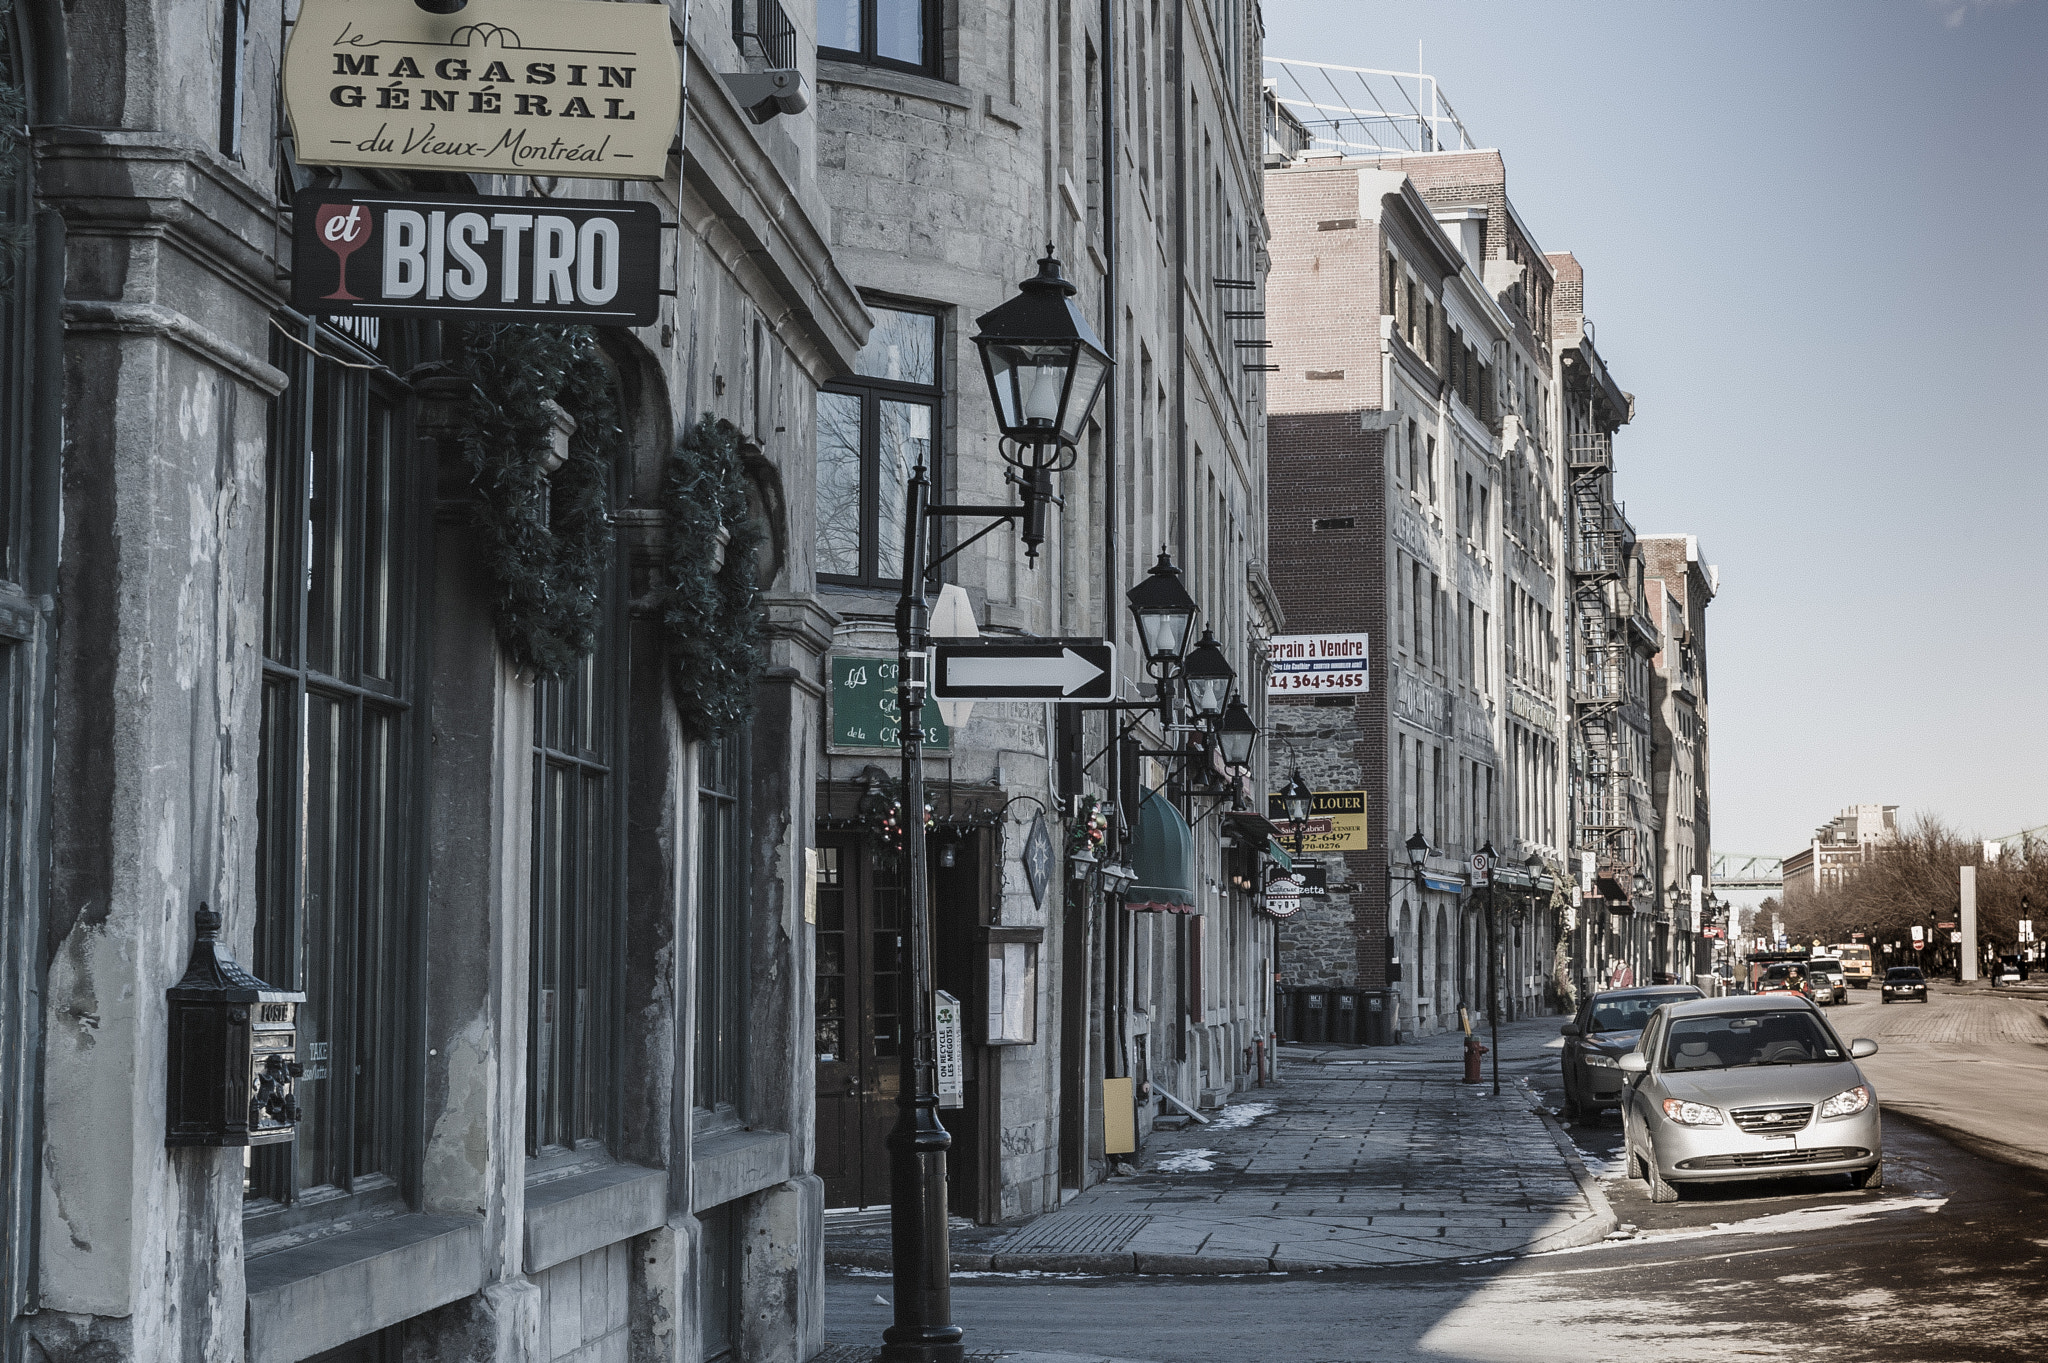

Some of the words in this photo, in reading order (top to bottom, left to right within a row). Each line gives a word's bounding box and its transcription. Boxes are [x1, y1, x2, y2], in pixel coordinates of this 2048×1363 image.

[332, 52, 637, 89] MAGASIN
[329, 81, 636, 121] GÉNÉRAL
[355, 122, 394, 153] du
[400, 123, 611, 167] Vieux-Montréal
[324, 205, 362, 243] et
[381, 208, 620, 306] BISTRO
[1268, 641, 1304, 658] errain
[1309, 640, 1315, 657] à
[1320, 639, 1363, 657] Vendre
[1292, 674, 1363, 689] 364-5455
[847, 727, 857, 738] de
[858, 727, 866, 739] la
[1320, 797, 1361, 809] LOUER
[261, 1004, 288, 1022] POSTE
[310, 1042, 328, 1061] TAKE
[939, 1029, 947, 1064] RECYCLE
[940, 1066, 947, 1078] ON
